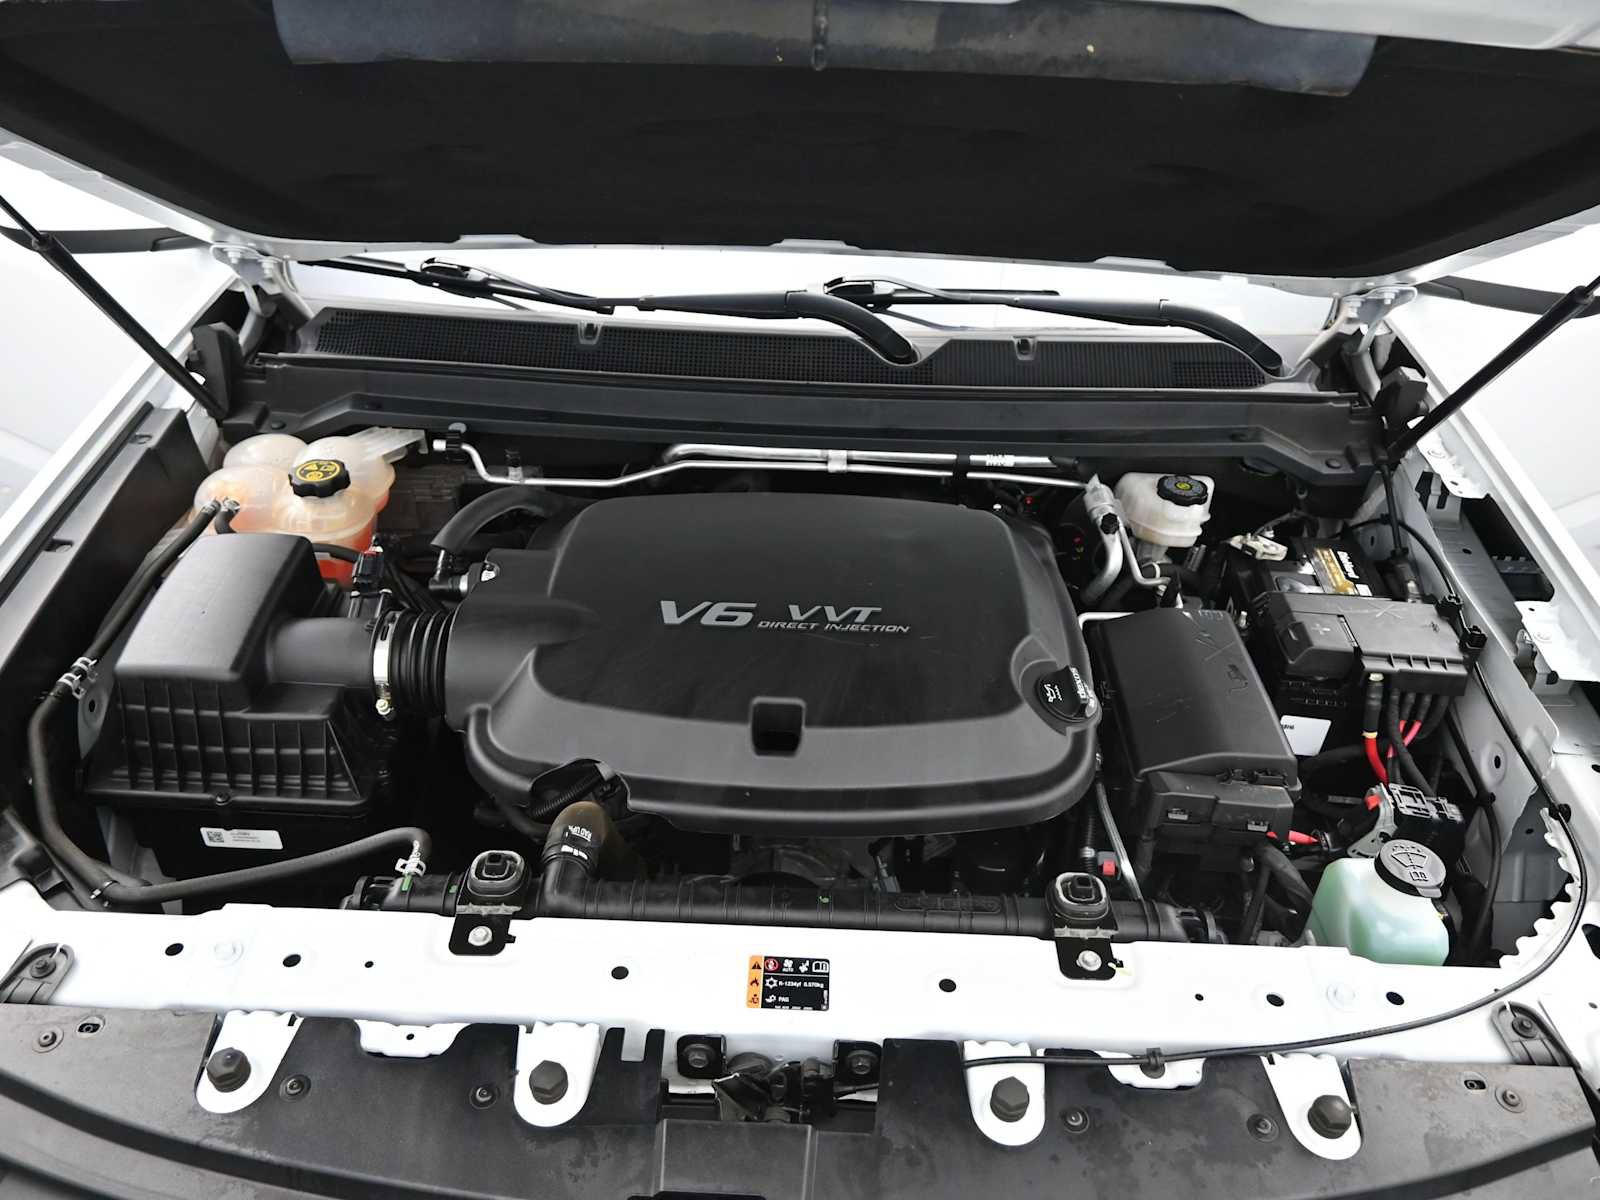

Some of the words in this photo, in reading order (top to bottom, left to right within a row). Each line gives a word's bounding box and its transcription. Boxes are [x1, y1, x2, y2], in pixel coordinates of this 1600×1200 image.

[660, 600, 757, 627] V6
[788, 604, 882, 623] VVT
[757, 620, 818, 631] DIRECT
[823, 622, 910, 634] INJECTION
